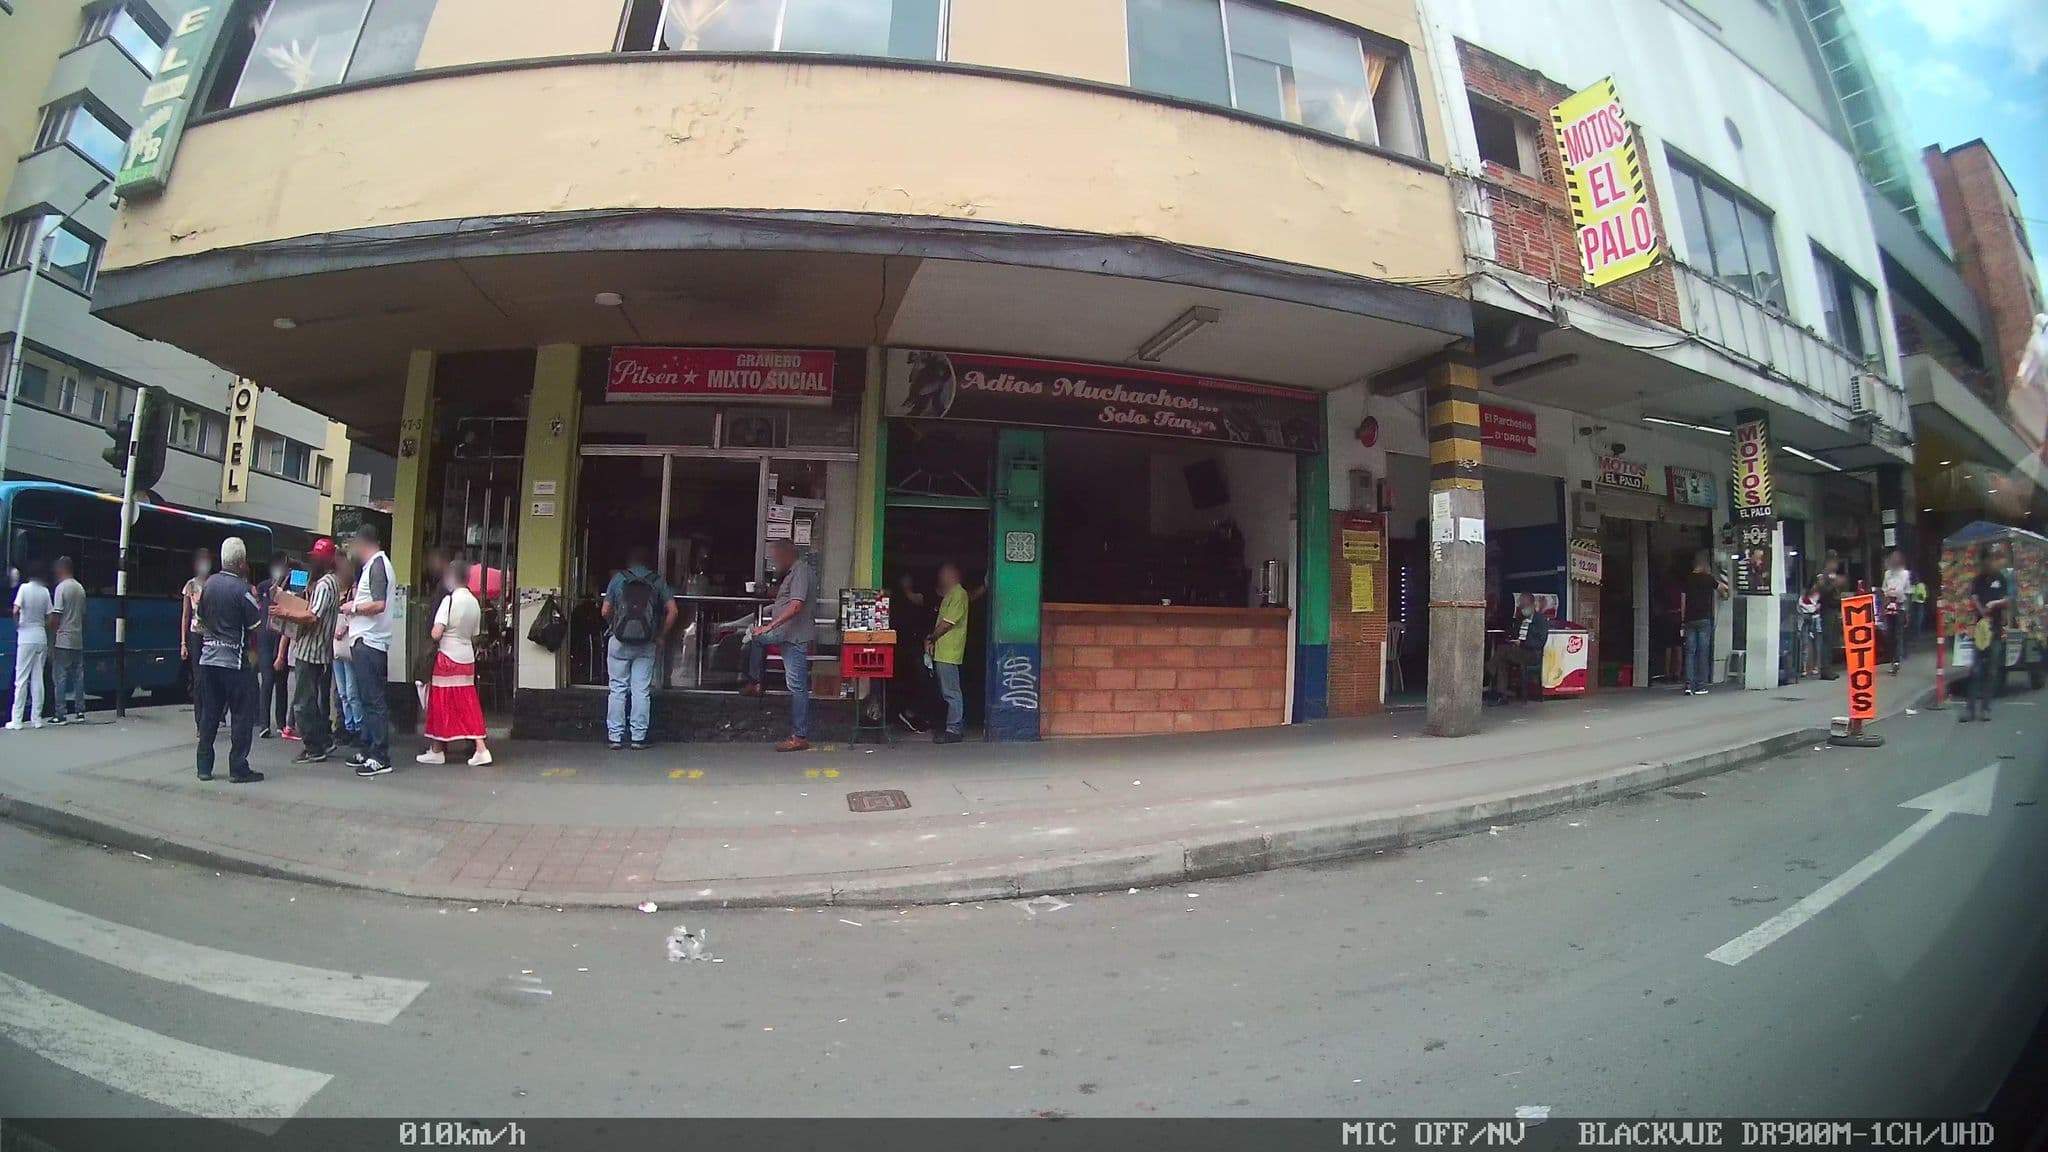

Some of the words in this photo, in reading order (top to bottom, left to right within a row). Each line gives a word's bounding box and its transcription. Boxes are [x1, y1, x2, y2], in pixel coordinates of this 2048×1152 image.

[1563, 103, 1625, 167] MOTOS
[1588, 161, 1627, 209] EL
[1581, 205, 1653, 271] PALO
[611, 359, 681, 386] Pilsen
[735, 352, 801, 368] GRANERO
[707, 369, 760, 389] MIXTO
[761, 370, 828, 392] SOCIAL
[960, 370, 1044, 394] Adios
[1098, 405, 1150, 426] Solo
[1153, 410, 1218, 435] Tango
[228, 378, 254, 492] OTEL
[1600, 456, 1648, 477] MOTOS
[1738, 425, 1761, 506] MOTOS
[1605, 473, 1617, 484] EL
[1619, 475, 1641, 488] PALO
[1740, 509, 1750, 518] EL
[1751, 506, 1772, 517] PALO
[1844, 602, 1873, 712] MOTOS
